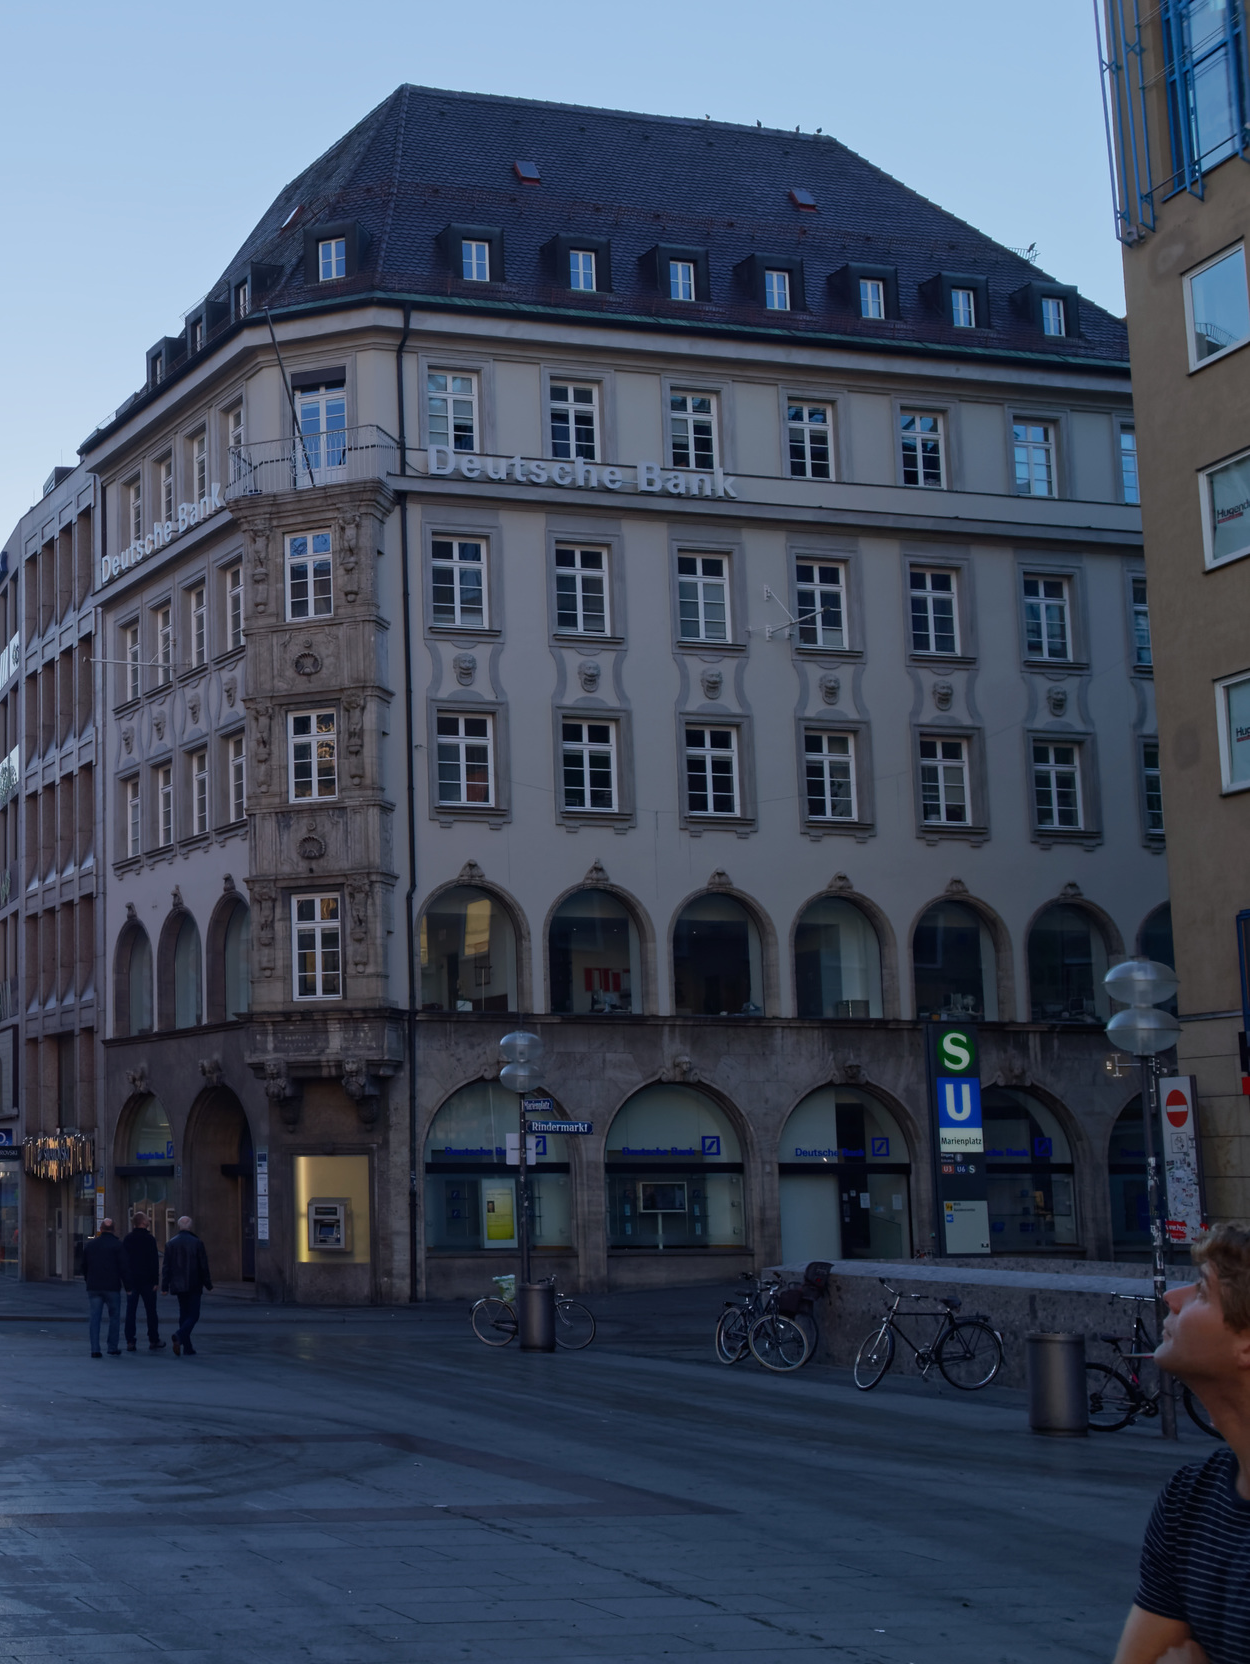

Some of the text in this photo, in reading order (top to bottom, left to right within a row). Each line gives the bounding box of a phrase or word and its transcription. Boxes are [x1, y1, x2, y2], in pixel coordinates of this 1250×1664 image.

[427, 444, 738, 499] Deutsche Bank
[102, 482, 223, 583] Deutsche Bank
[942, 1032, 970, 1071] S
[945, 1083, 971, 1121] U
[532, 1121, 588, 1133] Rindermarkt
[941, 1137, 982, 1146] Marienplatz
[445, 1147, 493, 1156] Deutsche
[622, 1147, 695, 1156] Deutsche Bank
[795, 1147, 840, 1157] Deutsche
[956, 1165, 966, 1173] U6
[969, 1165, 976, 1173] S
